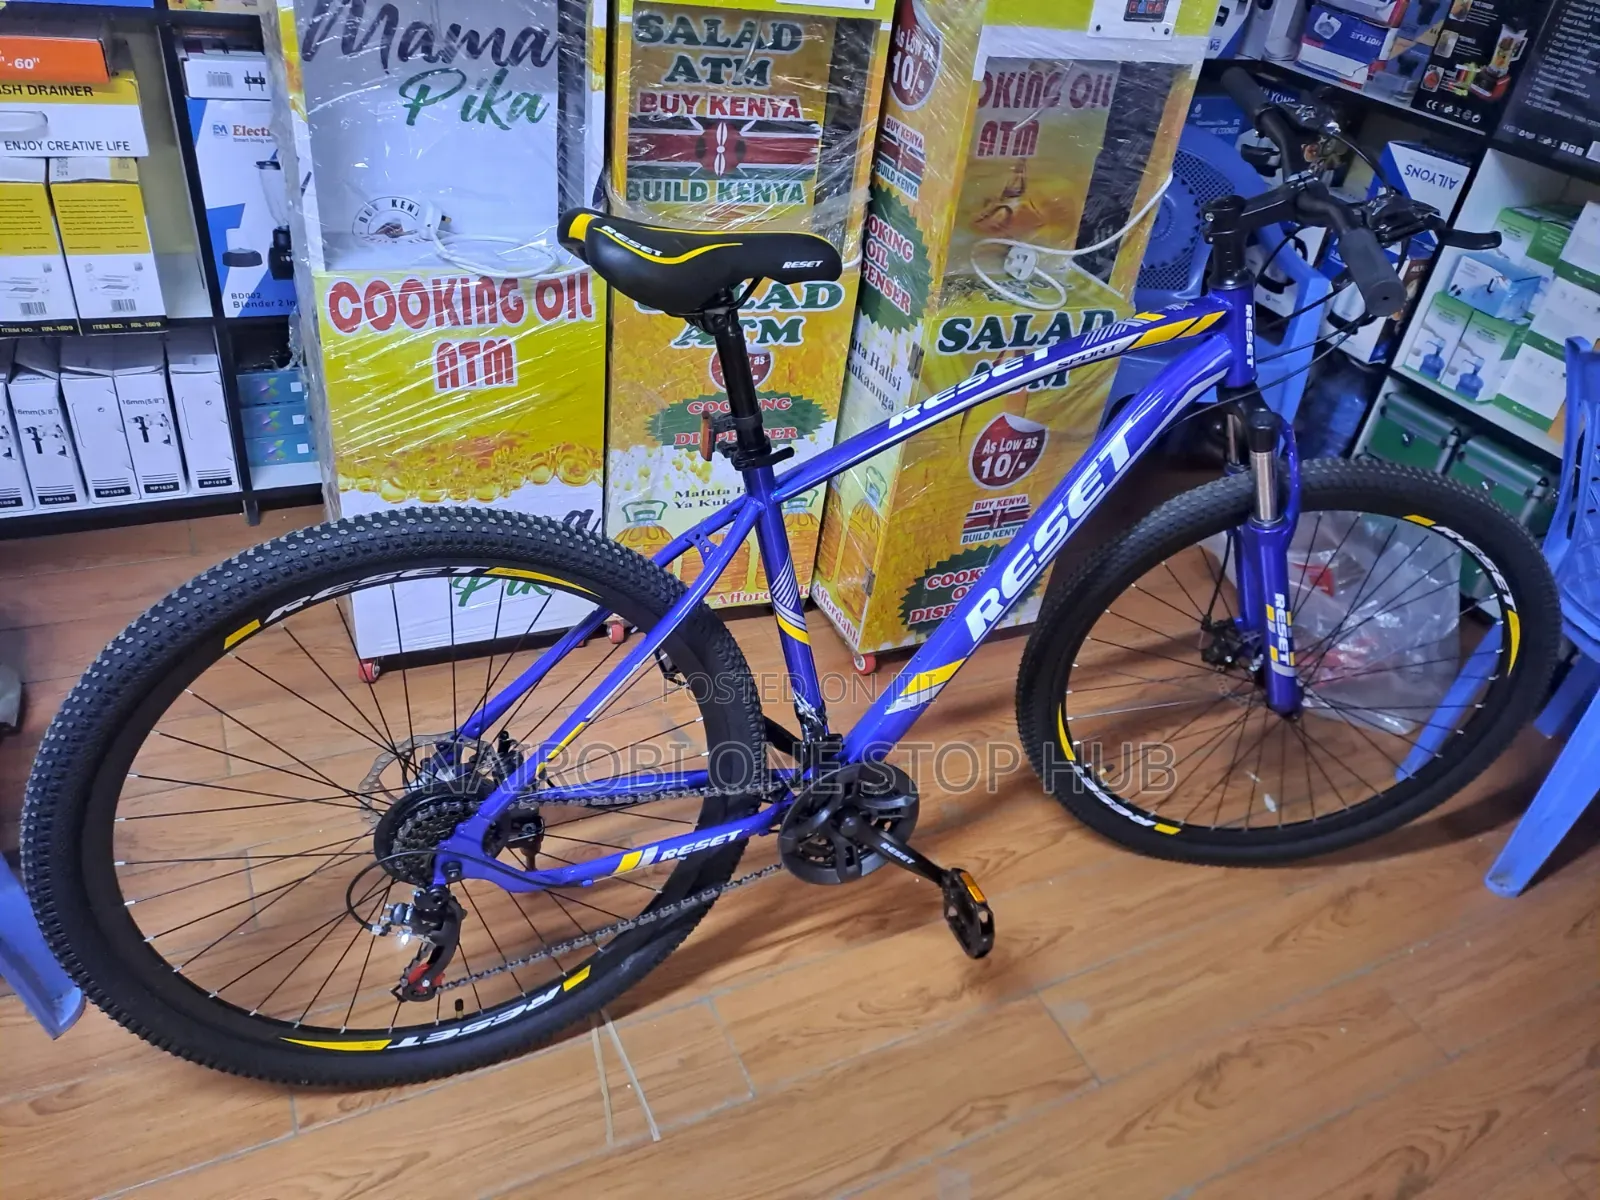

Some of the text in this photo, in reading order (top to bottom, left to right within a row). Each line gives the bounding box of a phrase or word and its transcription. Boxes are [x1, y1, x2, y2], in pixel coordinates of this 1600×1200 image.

[301, 0, 559, 74] Mama
[635, 14, 803, 51] SALAD
[664, 55, 772, 86] ATM
[26, 85, 94, 97] DRAINER
[399, 67, 550, 130] Pika
[639, 92, 801, 119] BUY KENYA
[4, 141, 131, 151] ENJOY CREATIVE LIFE
[886, 117, 923, 150] BUY KENYA
[977, 120, 1040, 156] ATM
[626, 178, 806, 204] BUILD KENYA
[876, 161, 918, 198] BUILD KENYA
[1404, 164, 1459, 190] AILYONS
[601, 225, 664, 256] RESET
[866, 238, 888, 272] OIL
[782, 260, 823, 269] RESET
[233, 300, 275, 308] Blender
[328, 272, 593, 333] COOKING OIL
[1245, 304, 1254, 368] RESET
[437, 339, 515, 389] ATM
[870, 351, 902, 392] Halisi
[1056, 343, 1121, 369] SPORT
[888, 346, 1050, 430] RESET
[983, 435, 1038, 453] As Low as
[981, 455, 1027, 479] 10/-
[674, 501, 692, 509] Ya
[675, 486, 731, 498] Mafuta
[974, 496, 1027, 510] BUY KENYA
[962, 528, 1019, 543] BUILD KENY
[965, 421, 1134, 643] RESET
[927, 568, 984, 589] COOK
[1431, 526, 1517, 612] RESET
[264, 565, 489, 624] RESET
[1274, 593, 1290, 666] RESET
[659, 829, 744, 861] RESET
[880, 842, 915, 864] RESET
[386, 985, 562, 1049] RESET
